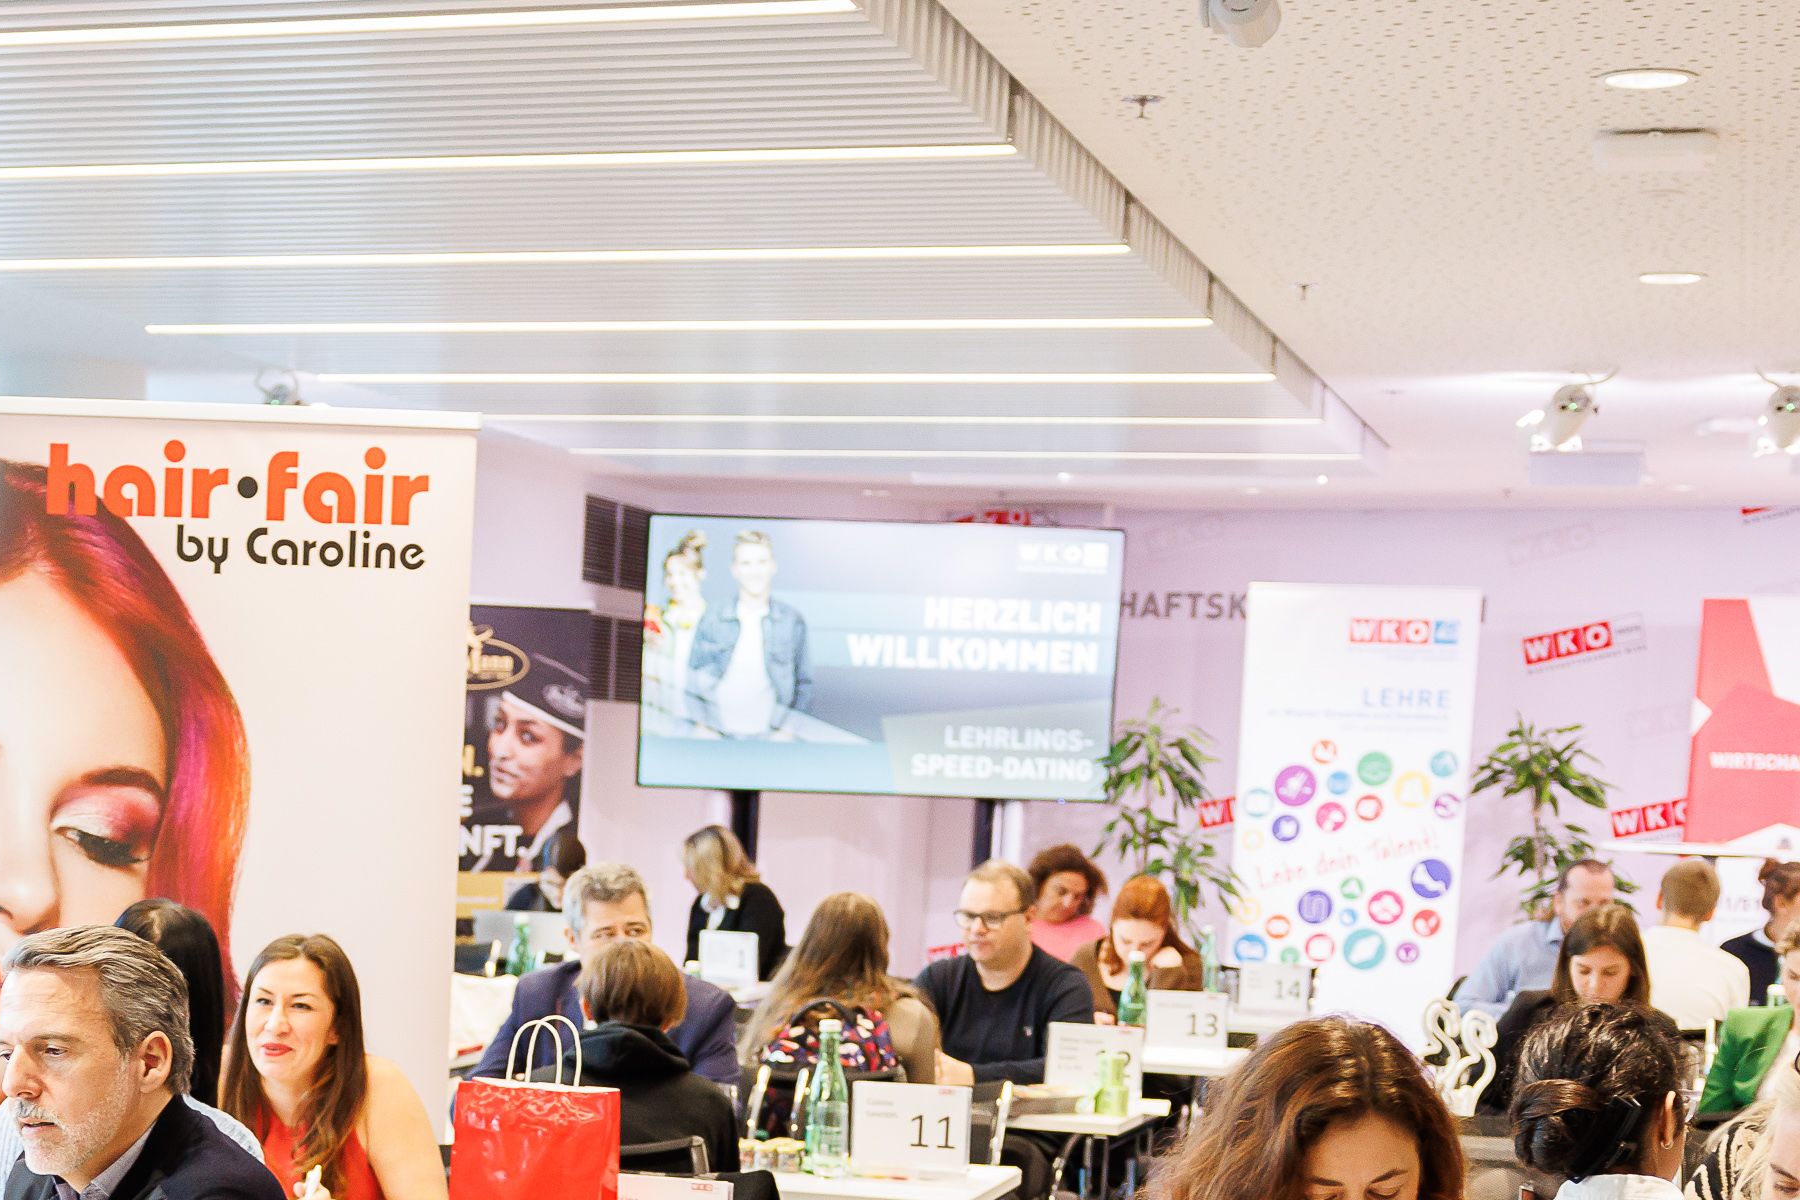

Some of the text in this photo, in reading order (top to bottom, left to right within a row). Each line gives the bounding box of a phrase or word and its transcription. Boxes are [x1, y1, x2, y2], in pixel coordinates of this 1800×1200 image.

[176, 525, 425, 574] by Caroline
[924, 597, 1101, 634] HERZLICH
[1351, 619, 1431, 643] WKO
[1524, 621, 1613, 664] WKO
[847, 634, 1098, 674] WILLKOMMEN
[1362, 687, 1451, 708] LEHRE
[944, 724, 1093, 753] LEHRLINGS-
[910, 753, 1093, 782] SPEED-DATING
[1274, 979, 1301, 1000] 14
[1185, 1012, 1218, 1037] 13
[910, 1114, 956, 1149] 11
